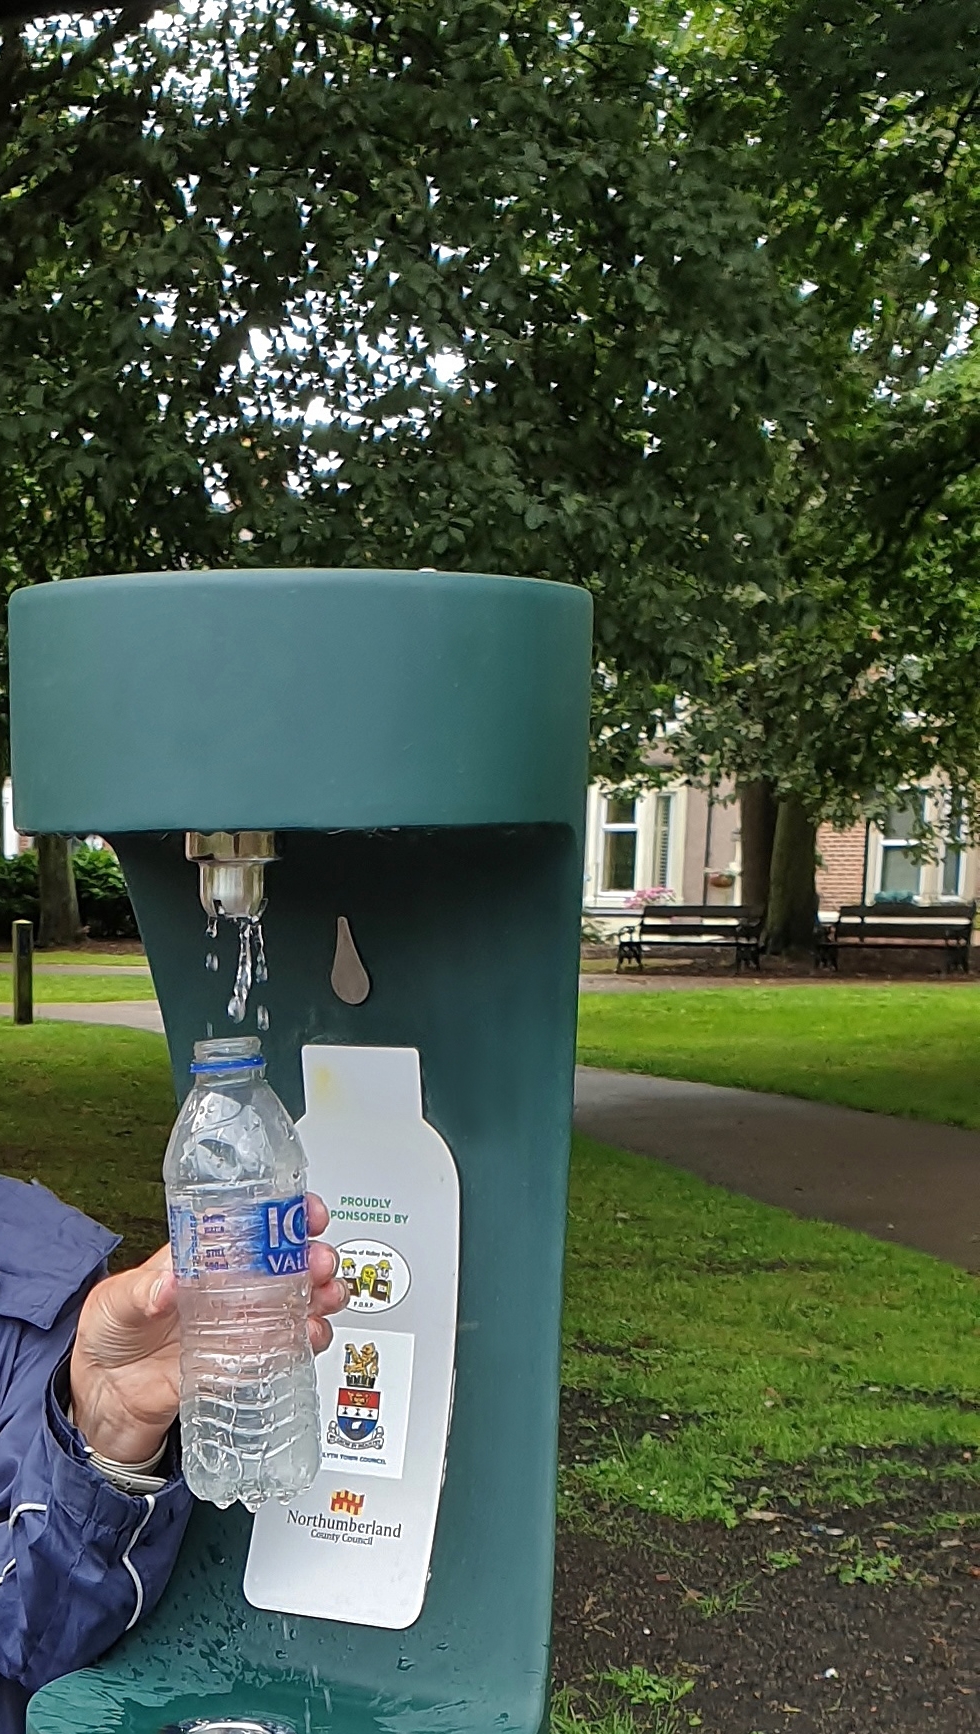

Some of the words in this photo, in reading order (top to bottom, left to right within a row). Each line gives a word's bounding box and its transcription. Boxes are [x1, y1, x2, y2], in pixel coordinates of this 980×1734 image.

[340, 1196, 391, 1208] PROUDLY
[330, 1210, 391, 1223] PONSORED
[394, 1213, 409, 1224] BY
[359, 1456, 386, 1465] COUNCIL
[287, 1509, 402, 1538] Northumberland
[310, 1528, 341, 1543] County
[342, 1533, 373, 1545] Council
